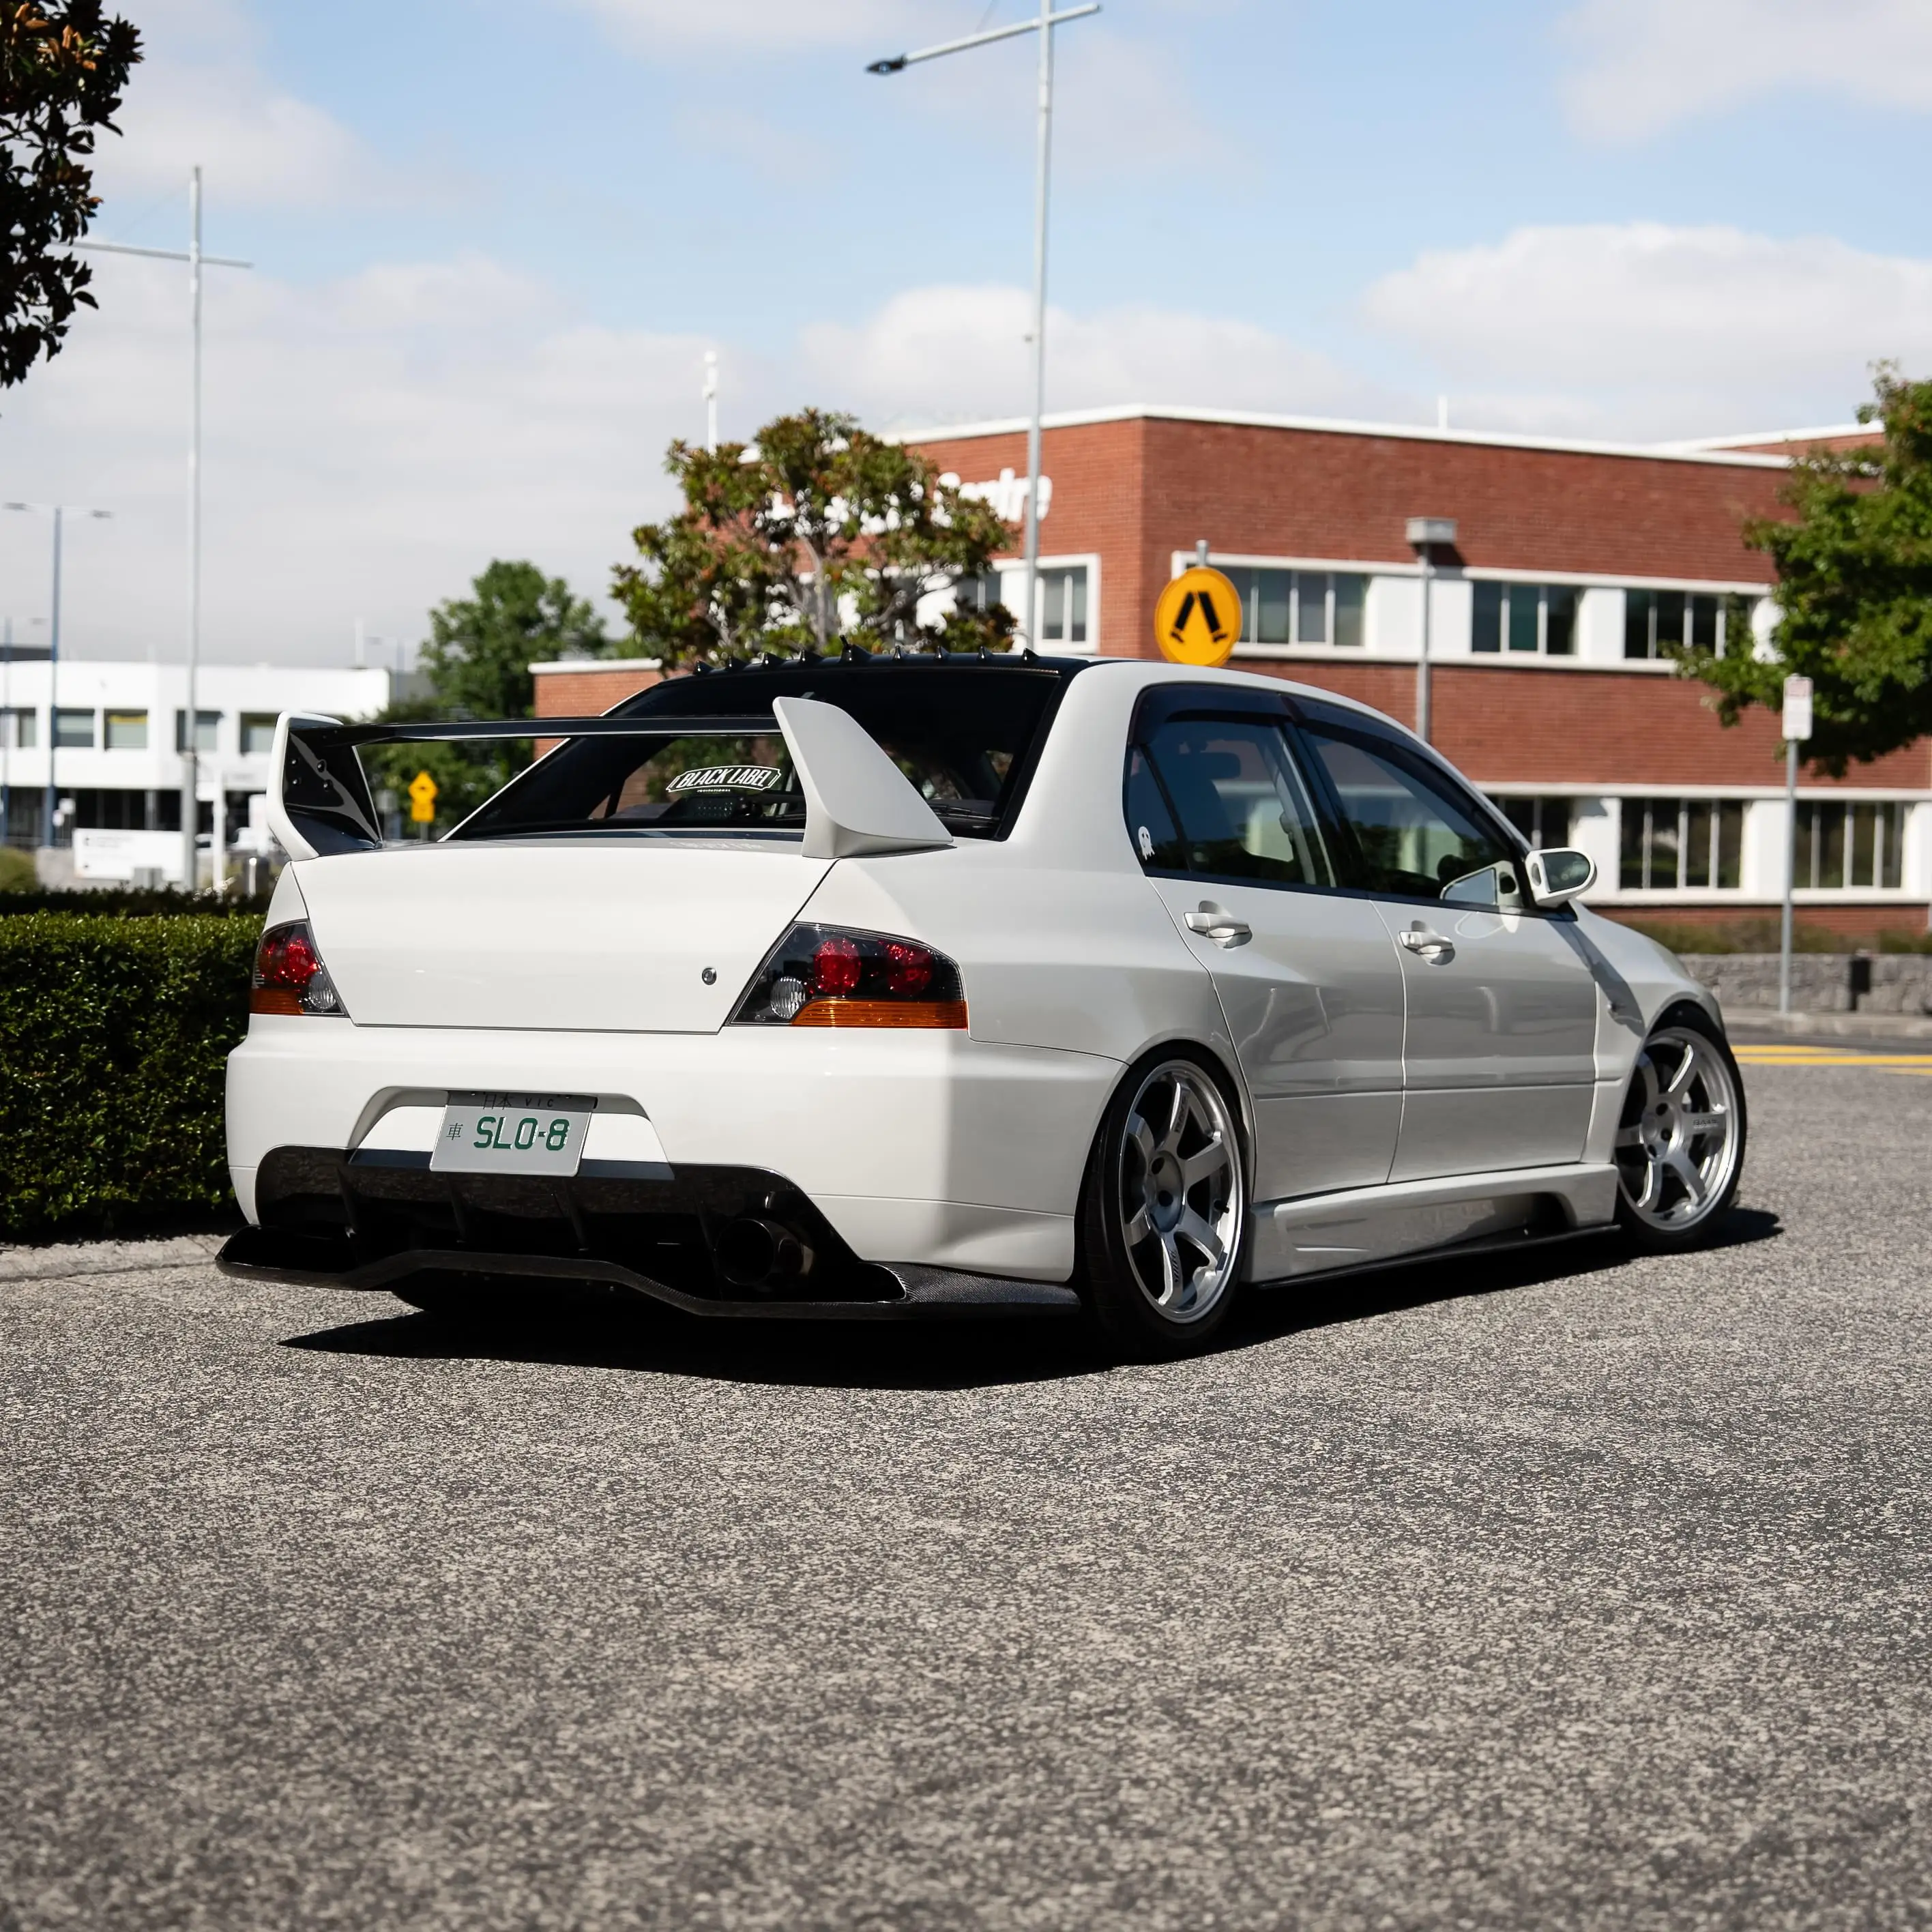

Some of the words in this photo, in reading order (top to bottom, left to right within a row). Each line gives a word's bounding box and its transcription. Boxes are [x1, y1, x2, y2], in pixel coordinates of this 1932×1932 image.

[676, 769, 734, 788] BLACK
[727, 768, 772, 787] LABEL
[525, 1098, 554, 1107] VIC
[446, 1123, 463, 1141] 車
